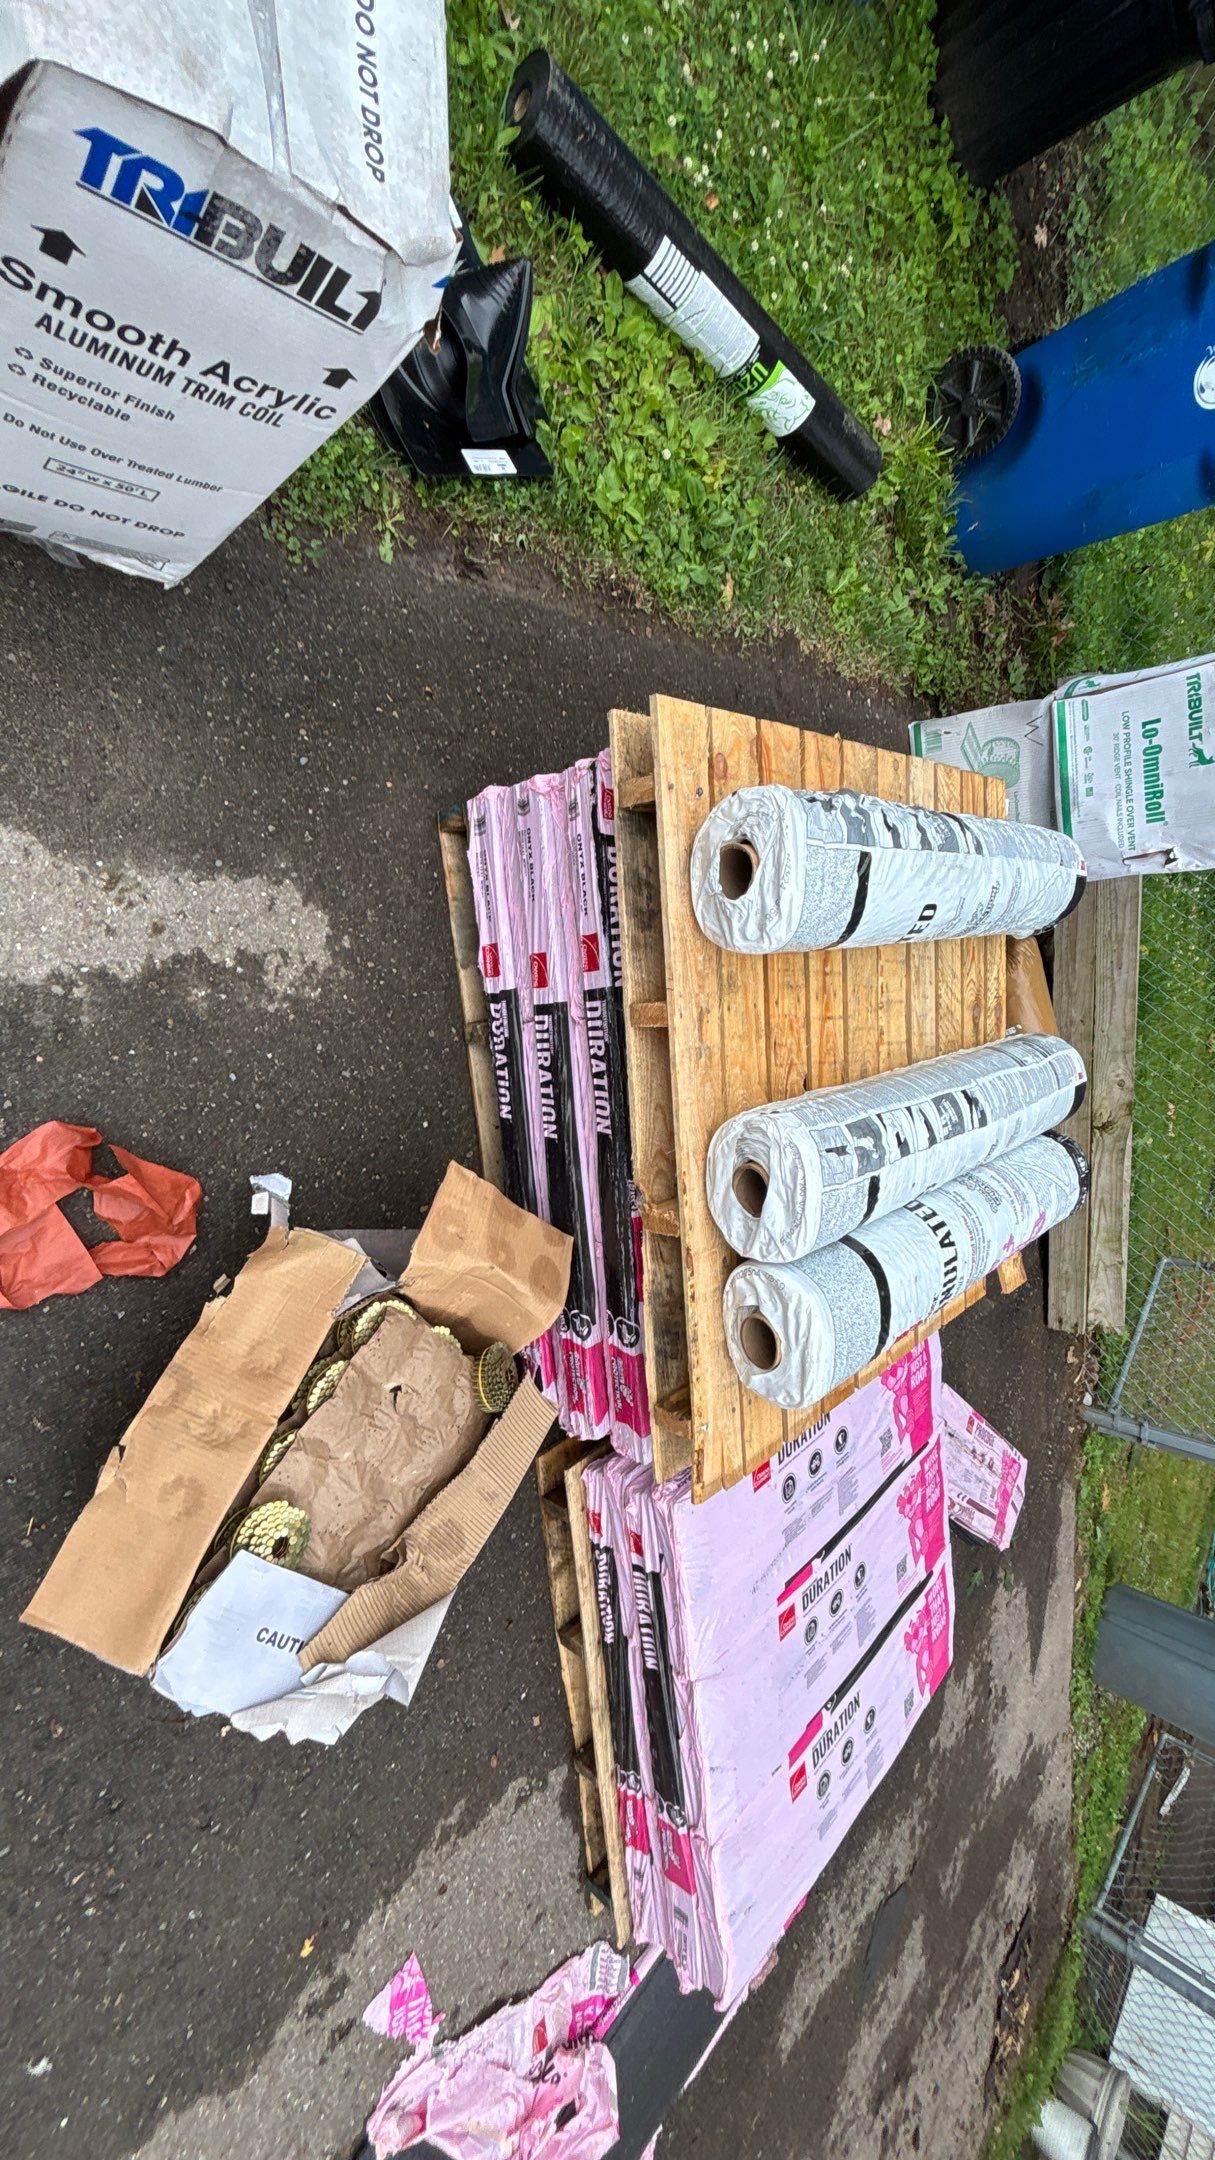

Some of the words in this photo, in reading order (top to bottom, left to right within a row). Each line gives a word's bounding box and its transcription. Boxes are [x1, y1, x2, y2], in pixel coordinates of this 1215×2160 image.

[356, 41, 379, 104] NOT
[361, 106, 385, 184] DROP
[0, 254, 193, 367] Smooth
[199, 359, 338, 421] Acrylic
[31, 373, 131, 423] Recyclable
[34, 312, 178, 389] ALUMINUM
[181, 376, 237, 411] TRIM
[238, 400, 283, 429] COIL
[38, 357, 121, 399] Superior
[122, 394, 177, 422] Finish
[3, 412, 25, 429] Do
[28, 421, 56, 440] Not
[58, 434, 87, 451] Use
[90, 444, 124, 465] Over
[126, 458, 175, 482] Treated
[176, 475, 224, 494] Lumber
[53, 498, 86, 514] DO
[90, 509, 131, 524] NOT
[133, 521, 186, 538] DROP
[1122, 710, 1130, 731] LOW
[1186, 672, 1204, 743] TRIBUILT
[1123, 732, 1133, 767] PROFILE
[1113, 743, 1121, 763] RIDGE
[1117, 817, 1126, 849] INCLUDED
[1124, 768, 1134, 805] SHINGLE
[1125, 805, 1135, 829] OVER
[526, 827, 534, 860] ONYX
[577, 833, 586, 869] ONYX
[1127, 829, 1137, 852] VENT
[581, 873, 589, 917] BLACK
[534, 1014, 558, 1140] DURATION
[585, 1000, 613, 1136] DURATION
[801, 1545, 852, 1612] DURATION
[812, 1691, 861, 1770] DURATION
